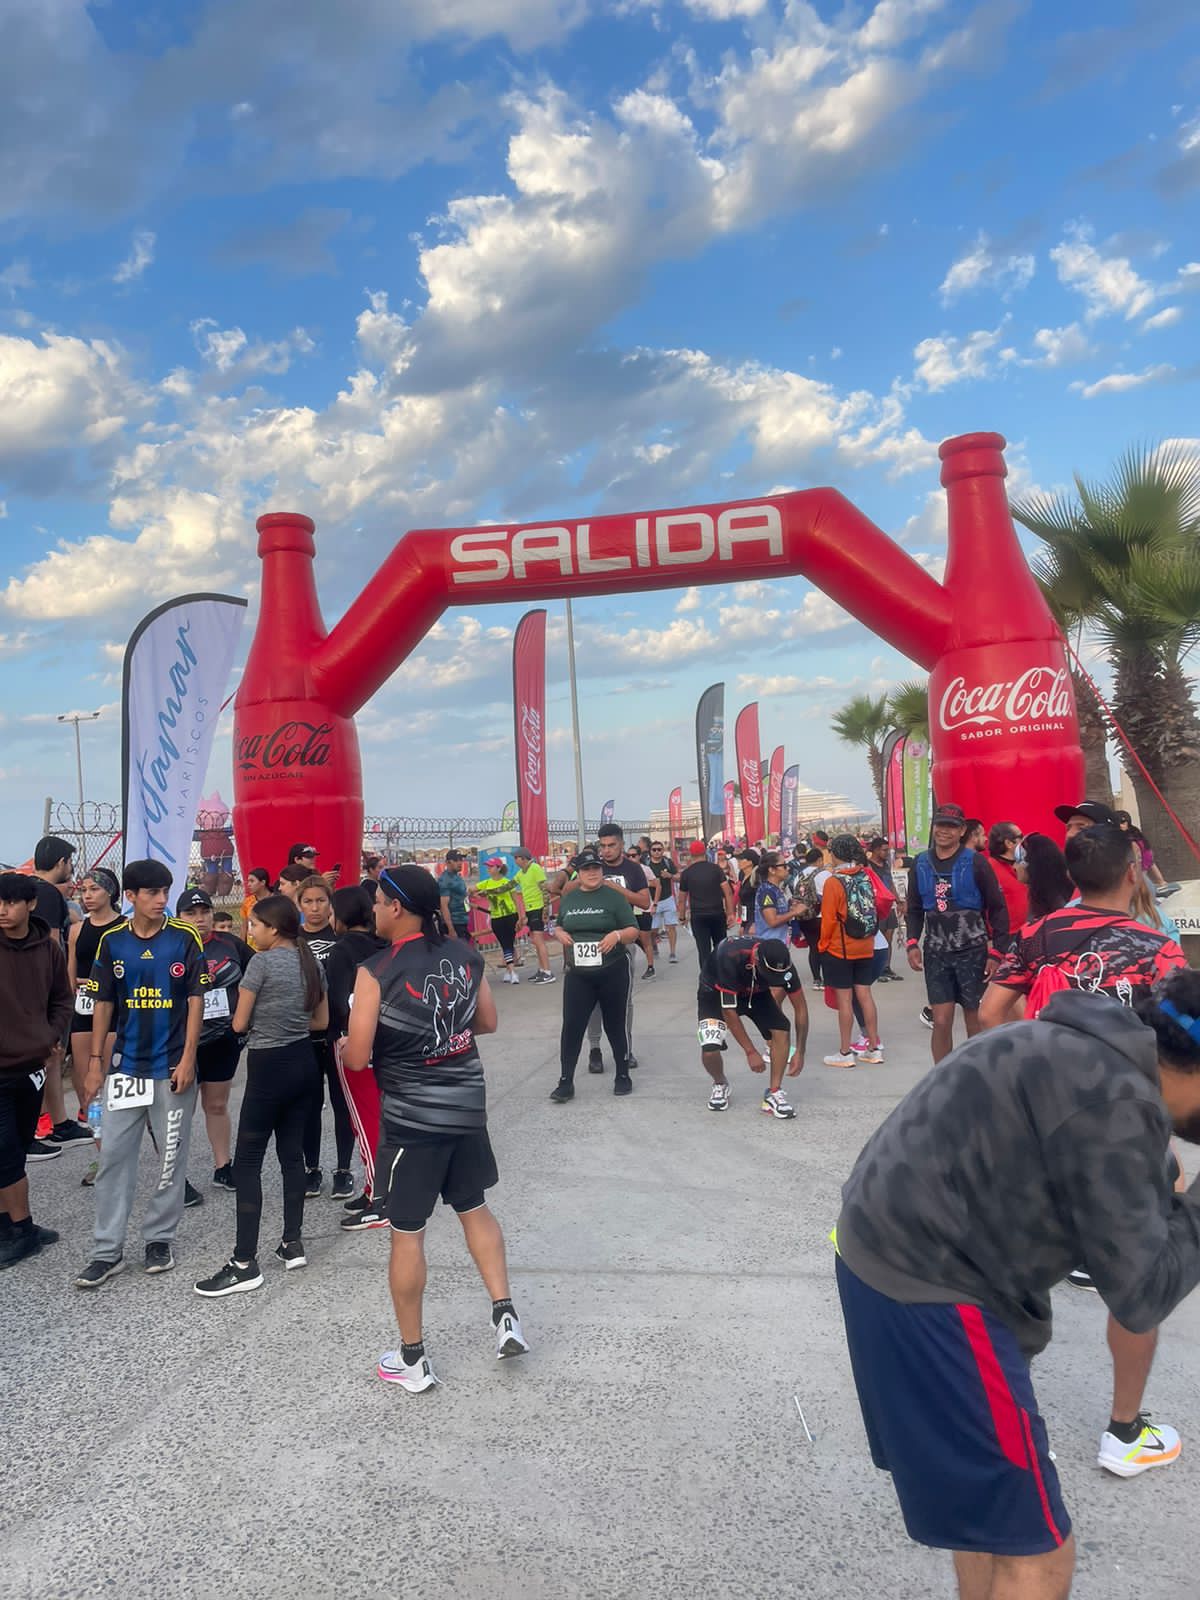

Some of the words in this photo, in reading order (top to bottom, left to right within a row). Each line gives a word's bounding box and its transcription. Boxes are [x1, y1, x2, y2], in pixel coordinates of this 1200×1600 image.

[450, 504, 784, 585] SALIDA
[939, 666, 1072, 731] Coca-Cola
[960, 728, 1003, 741] SABOR
[1009, 722, 1065, 734] ORIGINAL
[177, 696, 209, 819] MARISCOS
[1170, 918, 1200, 929] ERAL
[577, 943, 598, 958] 329
[704, 1029, 721, 1040] 992
[113, 1077, 147, 1100] 520
